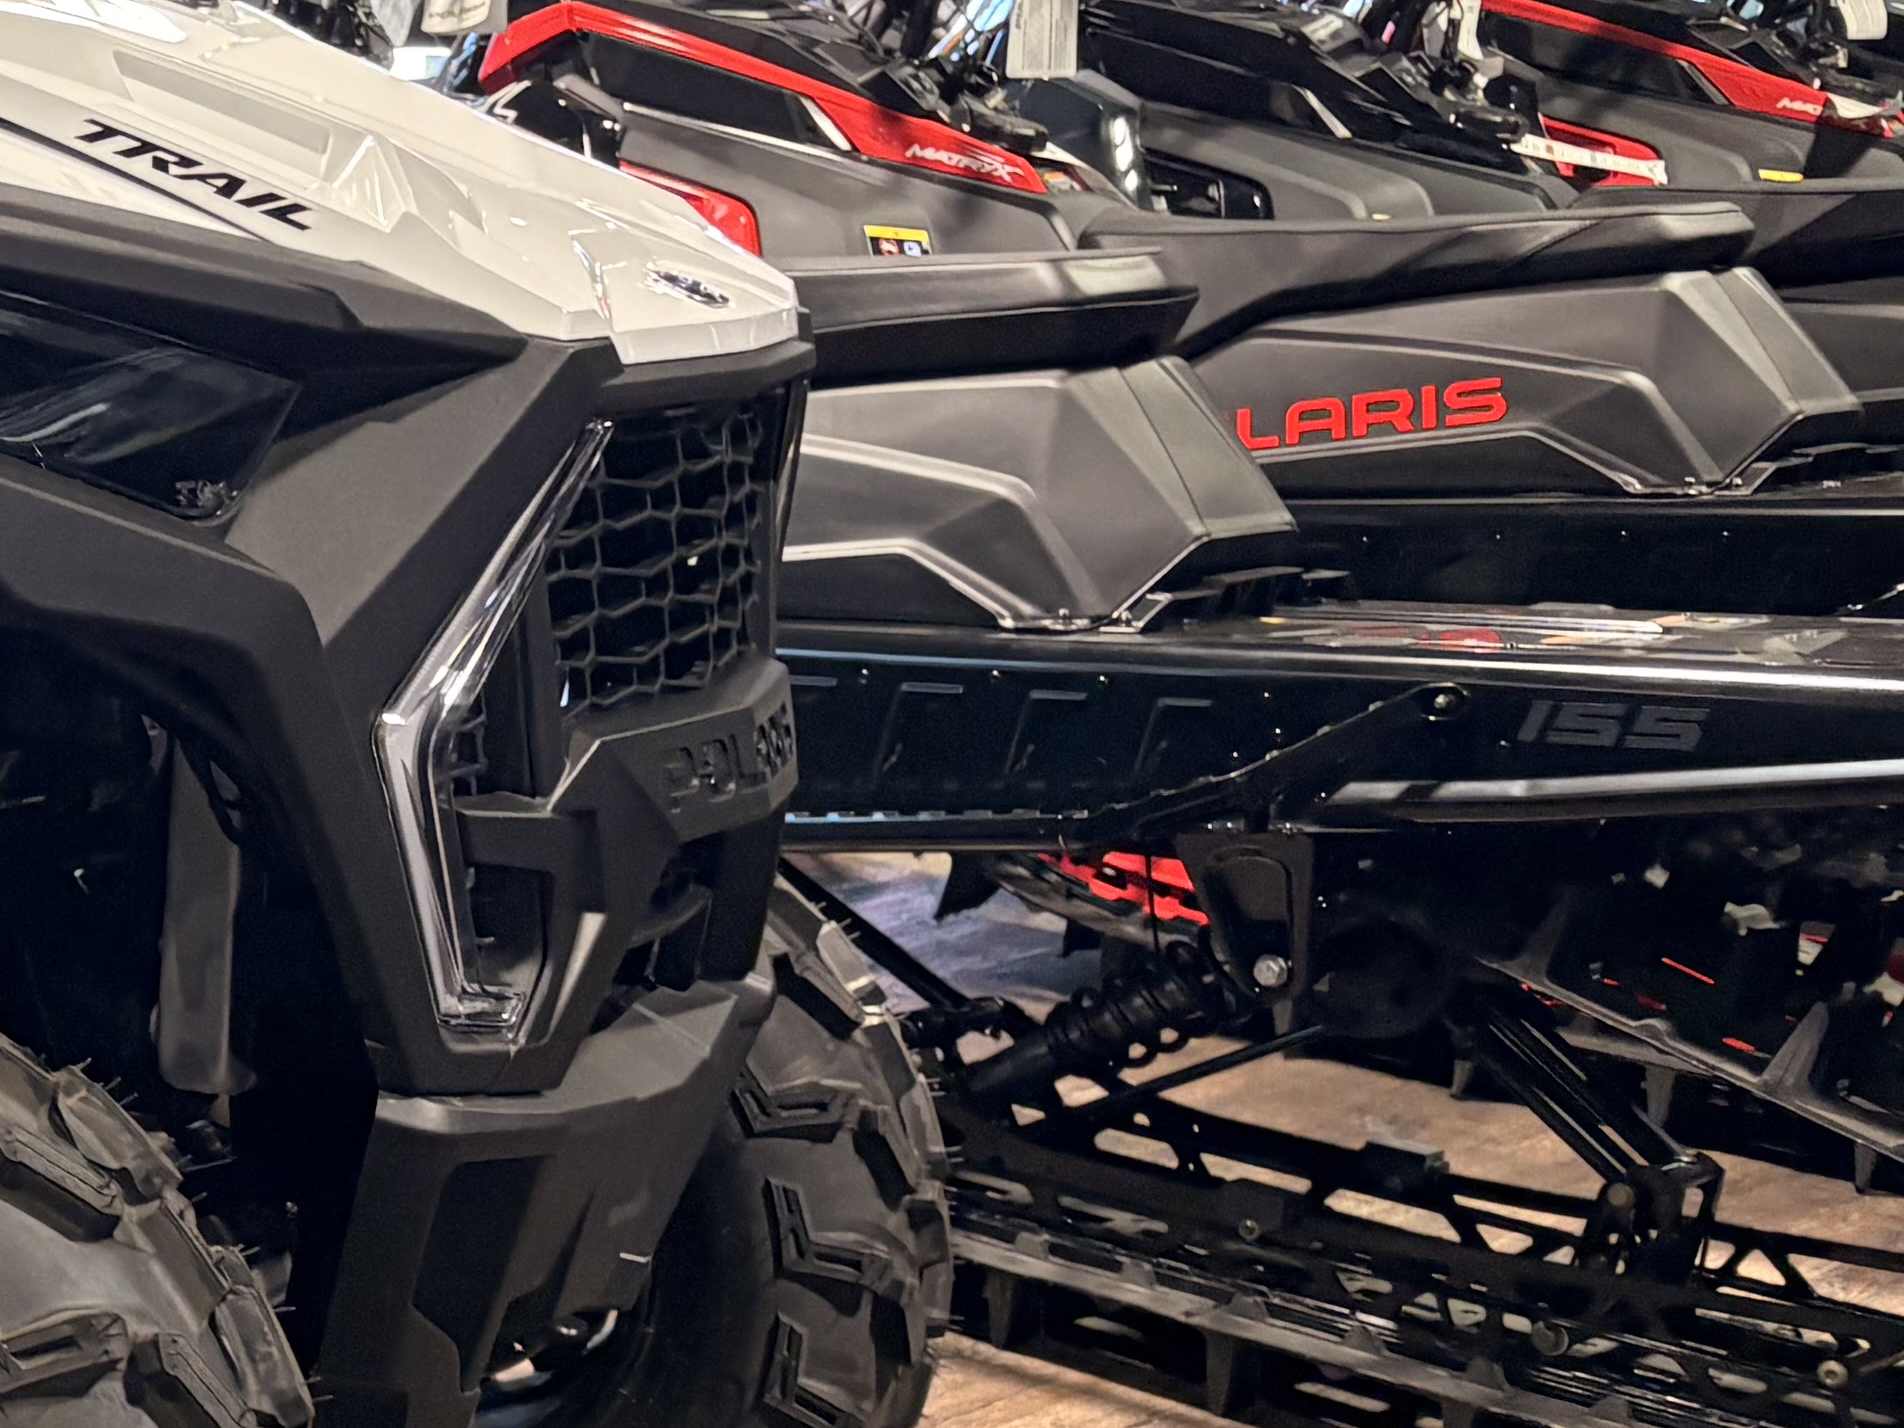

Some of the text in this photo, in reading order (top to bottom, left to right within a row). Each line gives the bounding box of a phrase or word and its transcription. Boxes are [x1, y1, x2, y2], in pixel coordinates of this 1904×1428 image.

[73, 118, 313, 232] TRAIL
[1225, 376, 1509, 451] LARIS
[1517, 698, 1712, 753] 155
